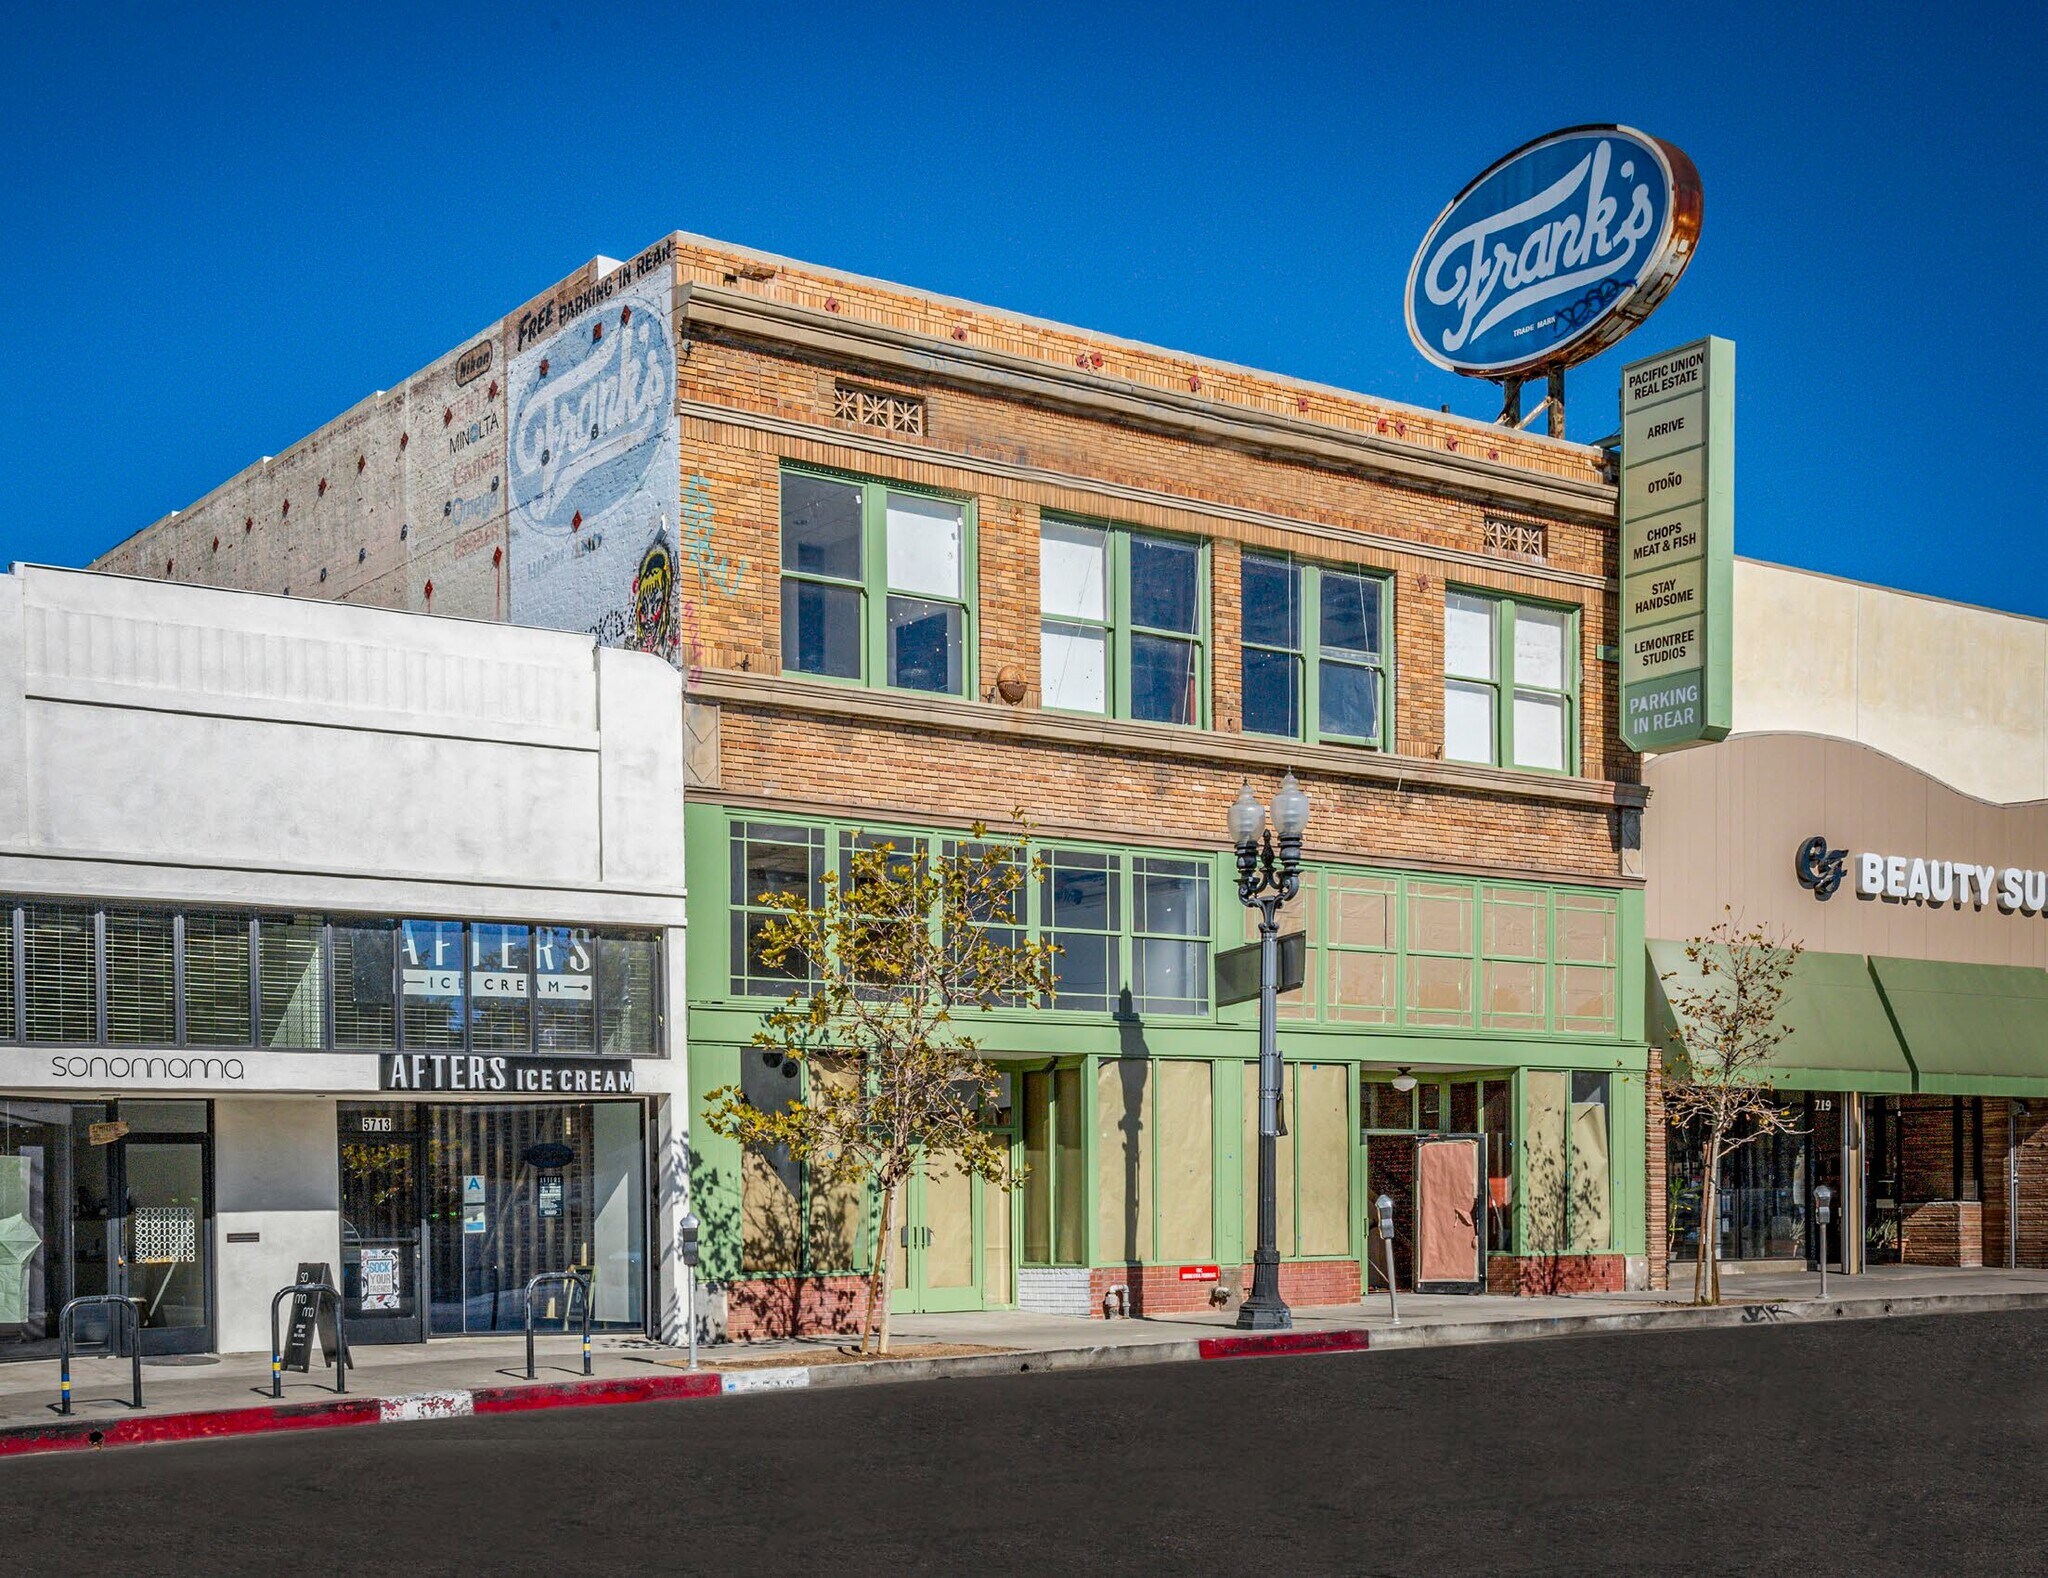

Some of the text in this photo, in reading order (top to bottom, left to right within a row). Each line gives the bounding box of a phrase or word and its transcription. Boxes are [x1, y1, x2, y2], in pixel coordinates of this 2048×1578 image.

[1425, 140, 1653, 351] Frank's
[517, 297, 555, 352] FREE
[558, 276, 613, 327] PARKING
[618, 265, 632, 289] IN
[460, 351, 490, 378] Nikon
[1629, 352, 1704, 388] PACIFIC UNION
[1634, 368, 1698, 400] REAL ESTATE
[450, 412, 500, 455] MINOLTA
[516, 322, 665, 520] Frank's
[1647, 417, 1685, 440] ARRIVE
[1648, 471, 1682, 494] OTOÑO
[1647, 522, 1682, 541] CHOPS
[1633, 532, 1696, 560] MEAT & FISH
[1652, 579, 1676, 595] STAY
[1635, 588, 1694, 614] HANDSOME
[1634, 629, 1695, 654] LEMONTREE
[1642, 646, 1686, 666] STUDIOS
[1630, 685, 1698, 714] PARKING
[1634, 708, 1694, 734] IN REAR
[1858, 853, 1995, 906] BEAUTY
[2001, 867, 2048, 911] SU
[429, 976, 464, 990] ICE
[52, 1056, 244, 1079] sonomama
[390, 1054, 634, 1092] AFTERS ICE CREAM
[363, 1118, 391, 1131] 5713
[468, 1177, 481, 1190] A
[369, 1261, 391, 1273] SOCK
[370, 1273, 391, 1285] YOUR
